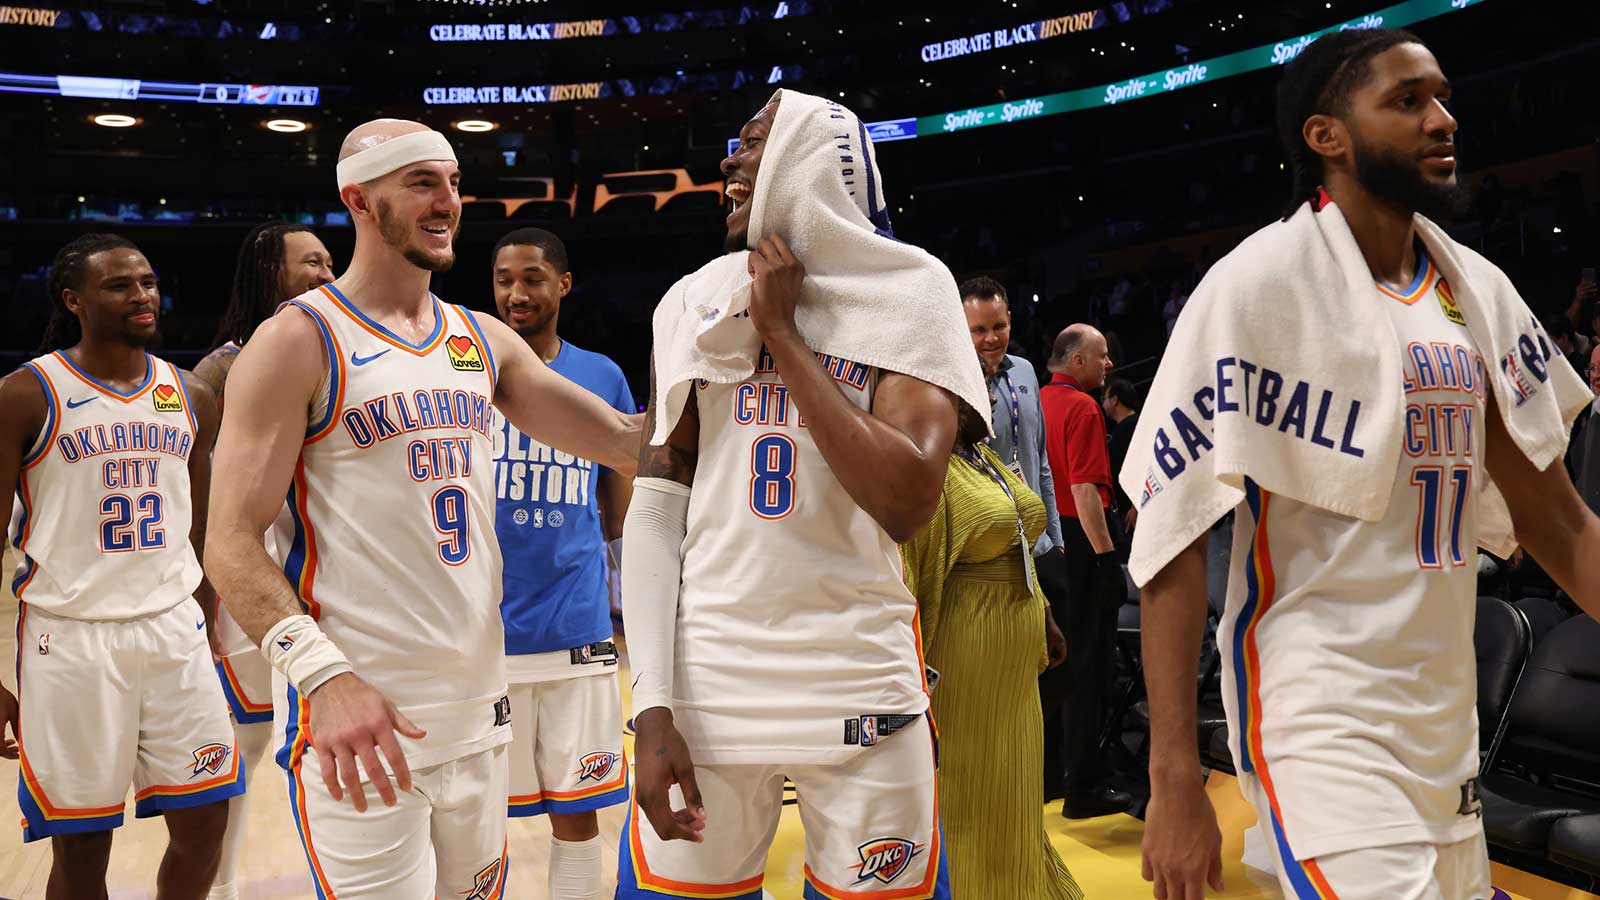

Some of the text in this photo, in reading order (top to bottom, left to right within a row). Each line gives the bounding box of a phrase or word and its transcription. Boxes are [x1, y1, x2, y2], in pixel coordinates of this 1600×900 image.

[430, 19, 607, 41] CELEBRATE BLACK HISTORY
[922, 9, 1098, 62] CELEBRATE BLACK HISTORY
[423, 82, 604, 104] CELEBRATE BLACK HISTORY
[1104, 79, 1145, 104] Sprite
[1163, 64, 1207, 91] Sprite
[943, 109, 984, 132] Sprite
[1001, 99, 1044, 122] Sprite
[734, 382, 808, 428] CIT
[1153, 356, 1365, 481] BASETBALL
[56, 421, 191, 463] OKLAHOMA
[1404, 403, 1475, 458] CITY
[102, 458, 160, 489] CITY
[407, 437, 472, 482] CITY
[749, 432, 798, 520] 8
[492, 461, 590, 506] ISTORY
[99, 491, 166, 553] 22
[431, 485, 471, 566] 9
[1410, 465, 1472, 569] 11
[858, 846, 903, 879] OKC
